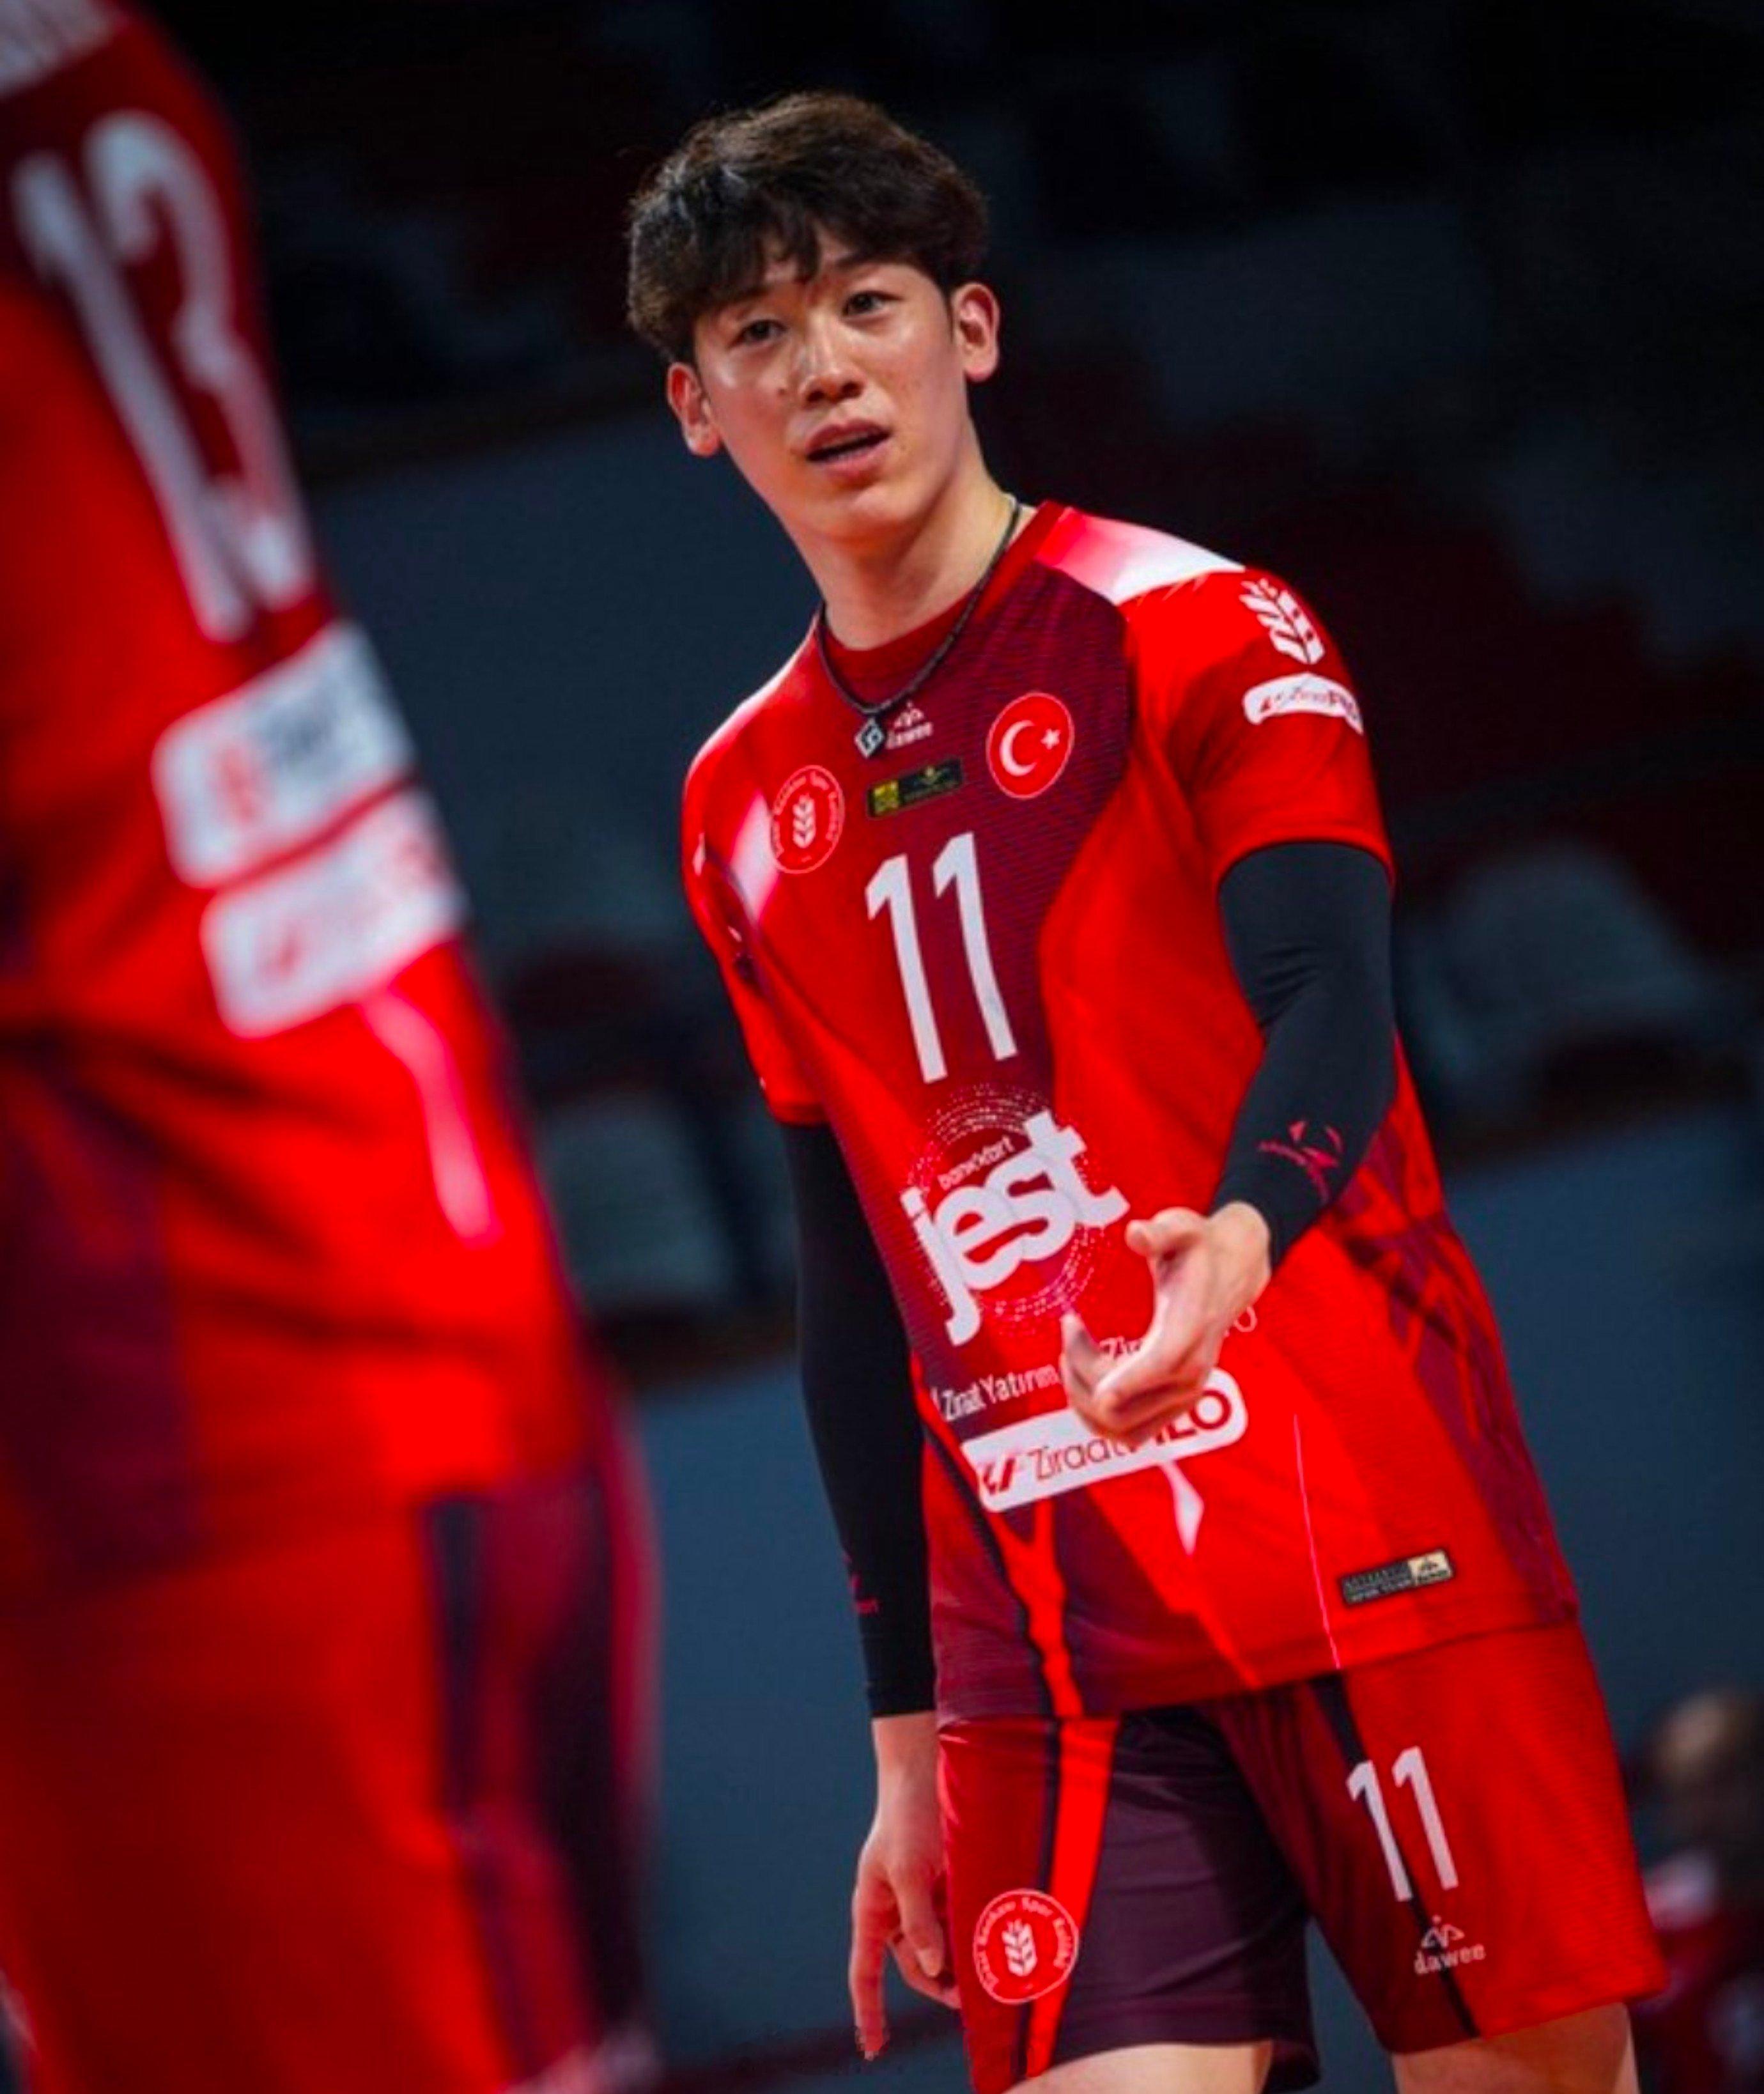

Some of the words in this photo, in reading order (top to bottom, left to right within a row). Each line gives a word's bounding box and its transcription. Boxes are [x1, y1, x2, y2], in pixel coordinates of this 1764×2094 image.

[13, 110, 313, 639] 13
[865, 832, 1017, 1083] 11
[901, 1111, 1129, 1346] jest
[1347, 1746, 1458, 1900] 11
[1413, 1943, 1486, 1975] dawee
